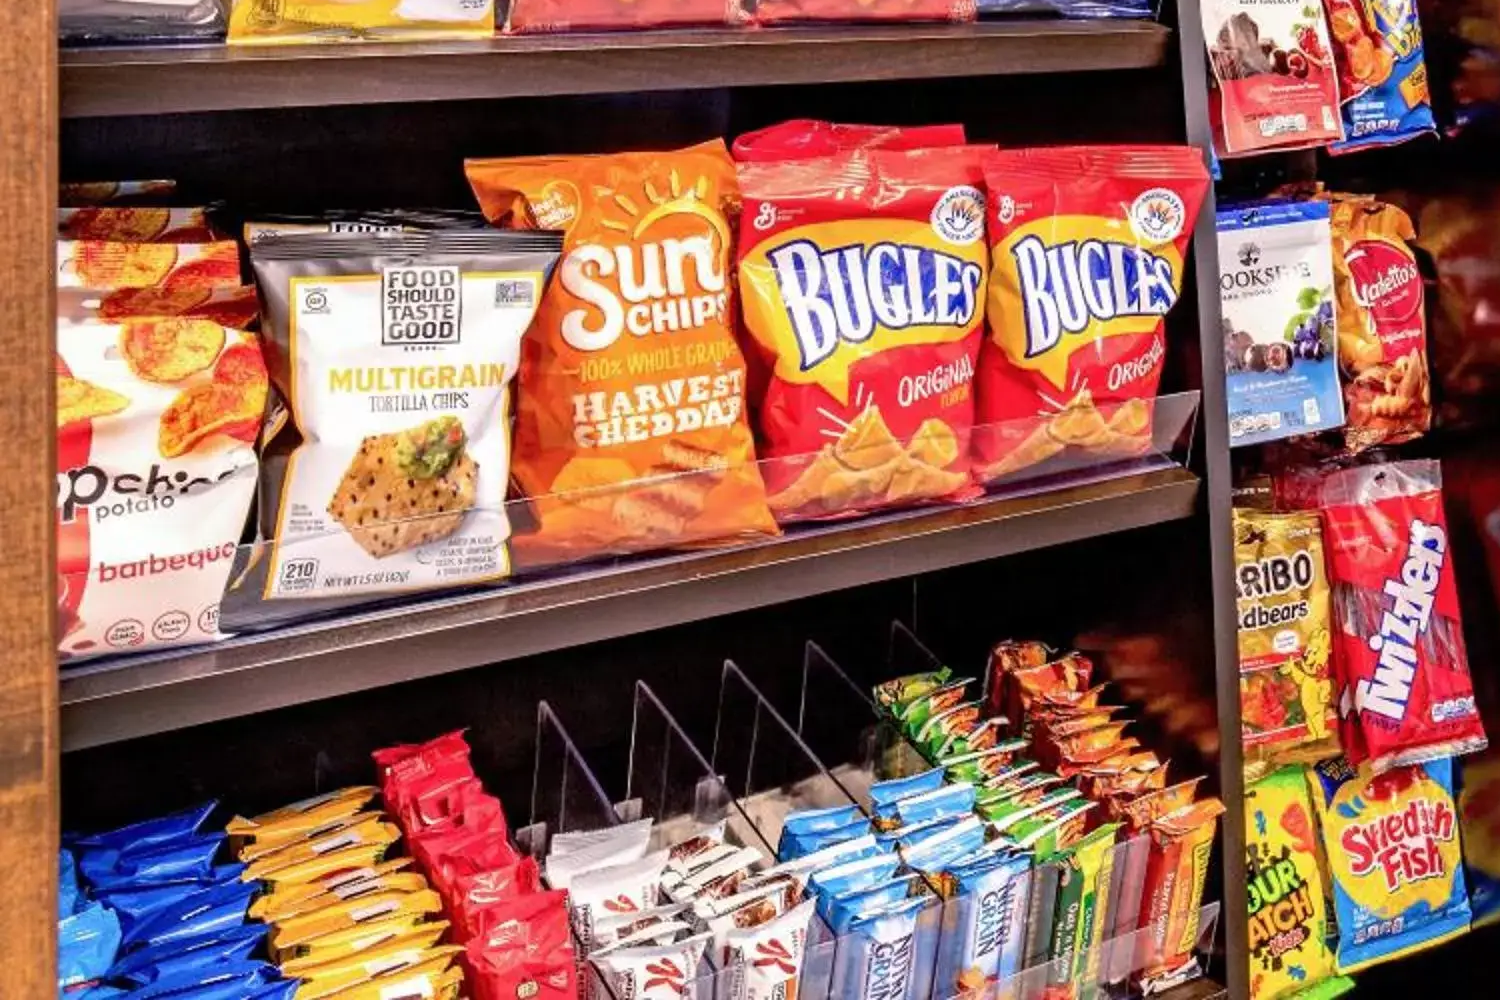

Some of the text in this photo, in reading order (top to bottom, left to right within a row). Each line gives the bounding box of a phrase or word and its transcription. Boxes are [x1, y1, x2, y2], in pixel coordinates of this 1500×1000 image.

[387, 270, 456, 289] FOOD
[560, 232, 727, 352] Sun
[387, 287, 456, 306] SHOULD
[770, 239, 982, 372] BUGLES
[1011, 234, 1180, 359] BUGLES
[386, 304, 455, 322] TASTE
[624, 294, 728, 337] CHIPS
[388, 321, 455, 341] GOOD
[626, 345, 683, 377] WHOLE
[329, 363, 507, 395] MULTIGRAIN
[574, 367, 744, 422] HARVEST
[898, 354, 976, 408] ORIGINAL
[368, 391, 470, 413] TORTILLA CHIPS
[95, 495, 175, 523] potato
[285, 562, 315, 580] 210
[1377, 838, 1444, 892] Fish
[976, 890, 999, 959] GRAIN
